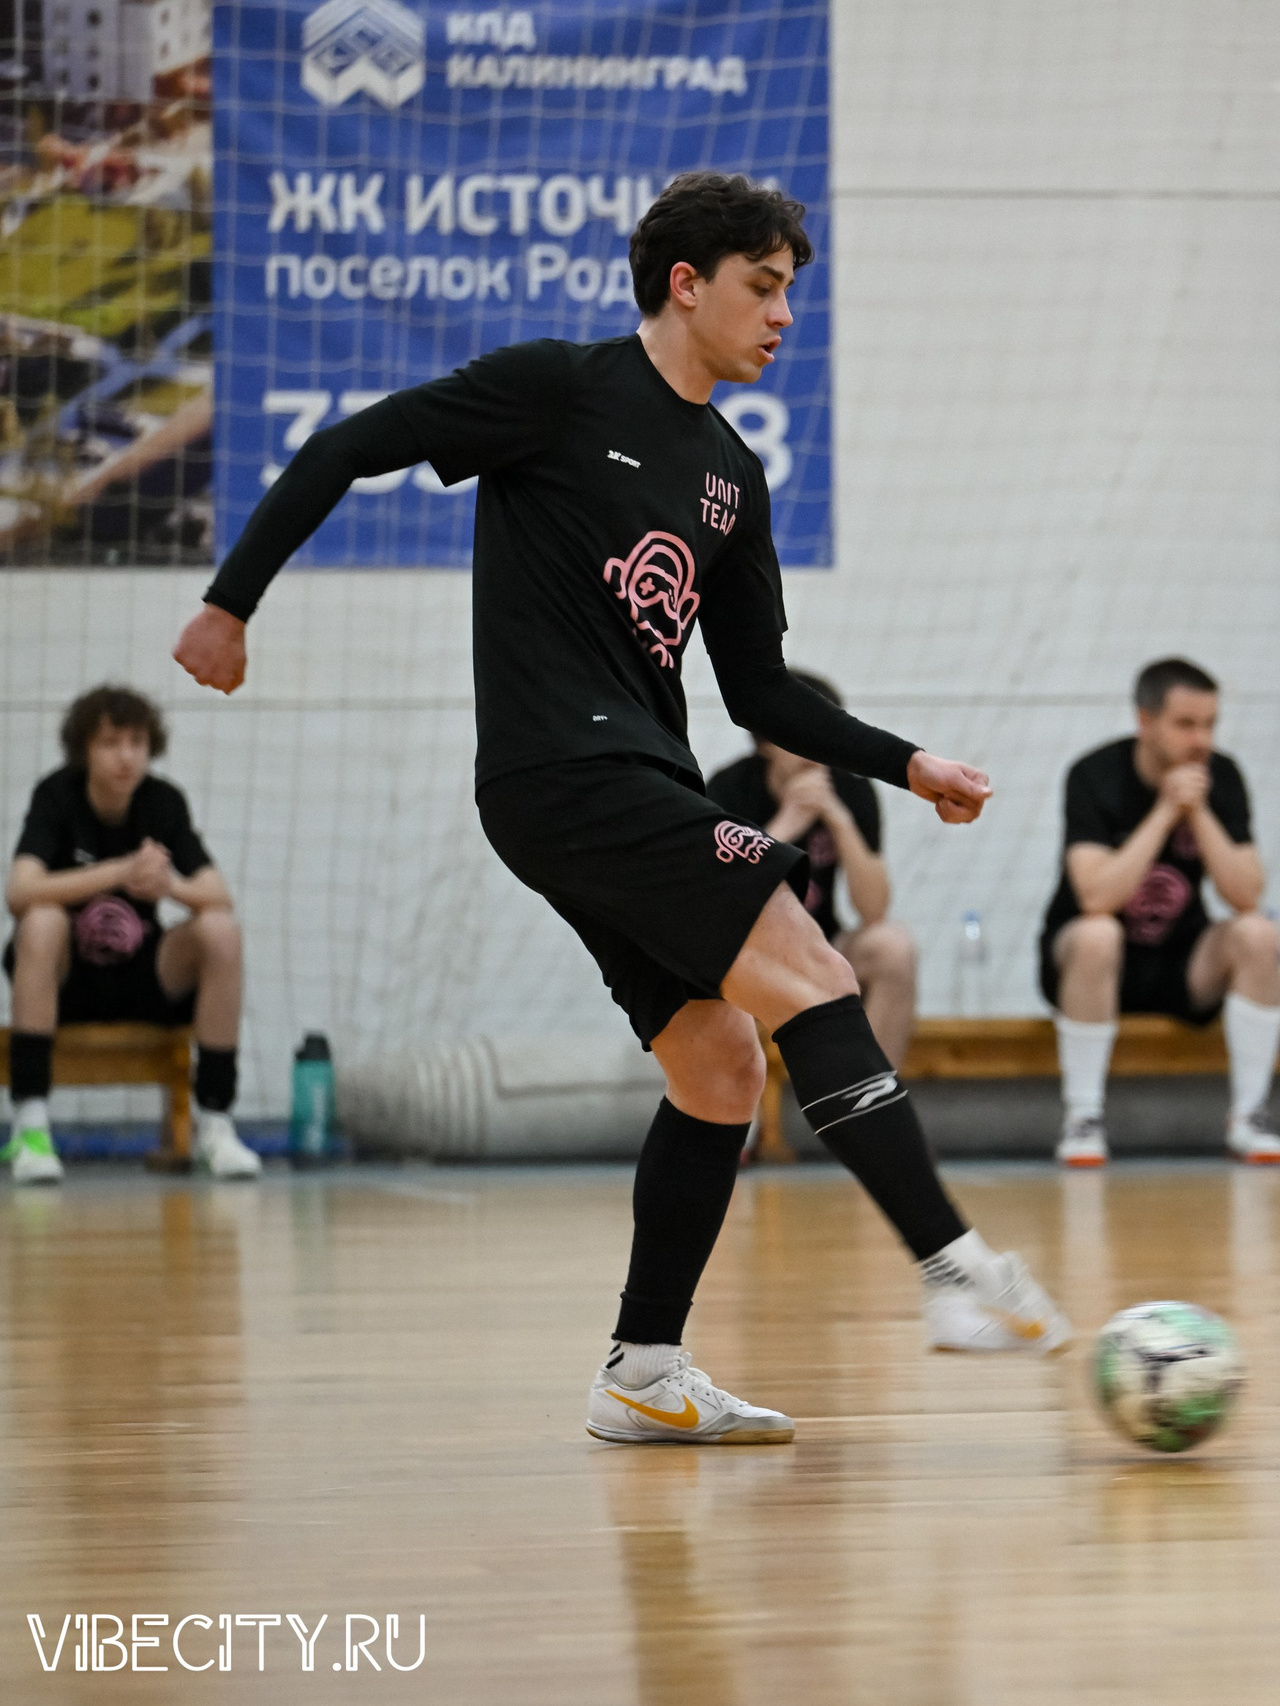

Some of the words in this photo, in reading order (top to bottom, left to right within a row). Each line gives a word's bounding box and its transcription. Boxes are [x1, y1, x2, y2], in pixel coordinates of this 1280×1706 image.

[446, 10, 536, 50] КПД
[446, 54, 748, 97] КАЛИНИНГРАД
[266, 172, 385, 234] ЖК
[404, 172, 778, 236] ИСТОЧ
[265, 253, 510, 300] поселок
[526, 243, 640, 311] Род
[705, 471, 740, 509] UNIT
